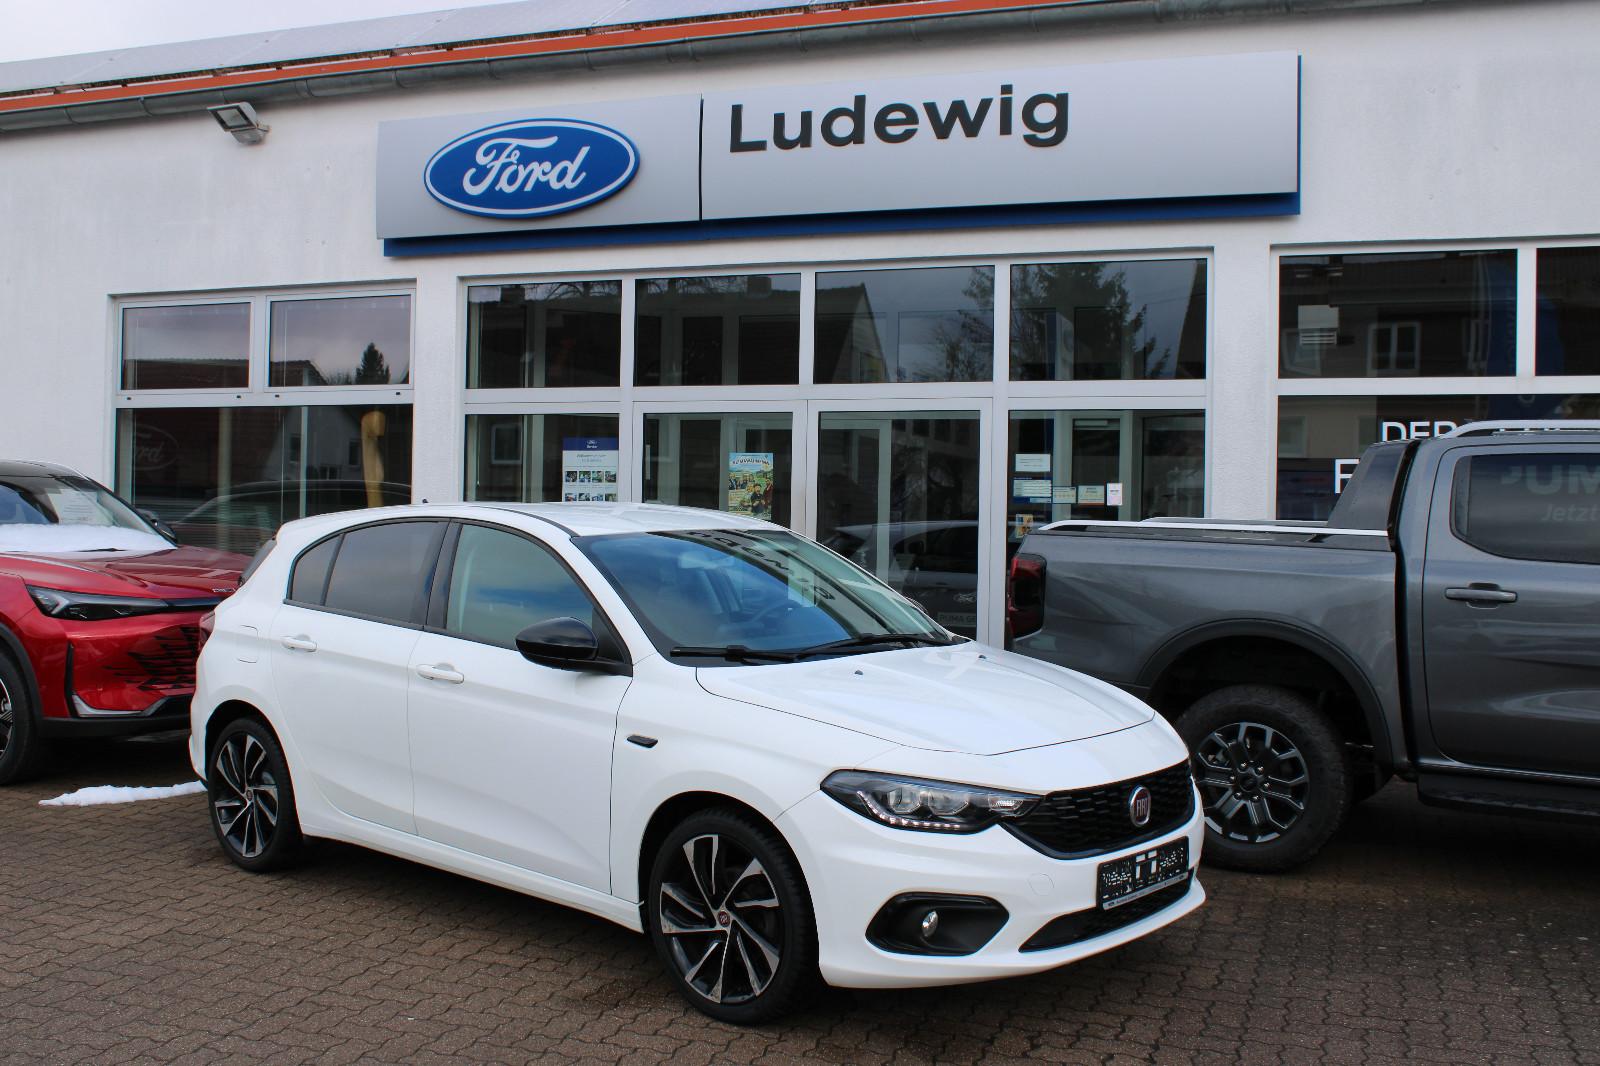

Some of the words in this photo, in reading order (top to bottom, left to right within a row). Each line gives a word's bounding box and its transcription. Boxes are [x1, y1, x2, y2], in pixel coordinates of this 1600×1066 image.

[729, 84, 1069, 153] Ludewig
[462, 136, 591, 196] Ford
[1540, 503, 1598, 521] Jetzt
[1136, 798, 1149, 816] FIAT
